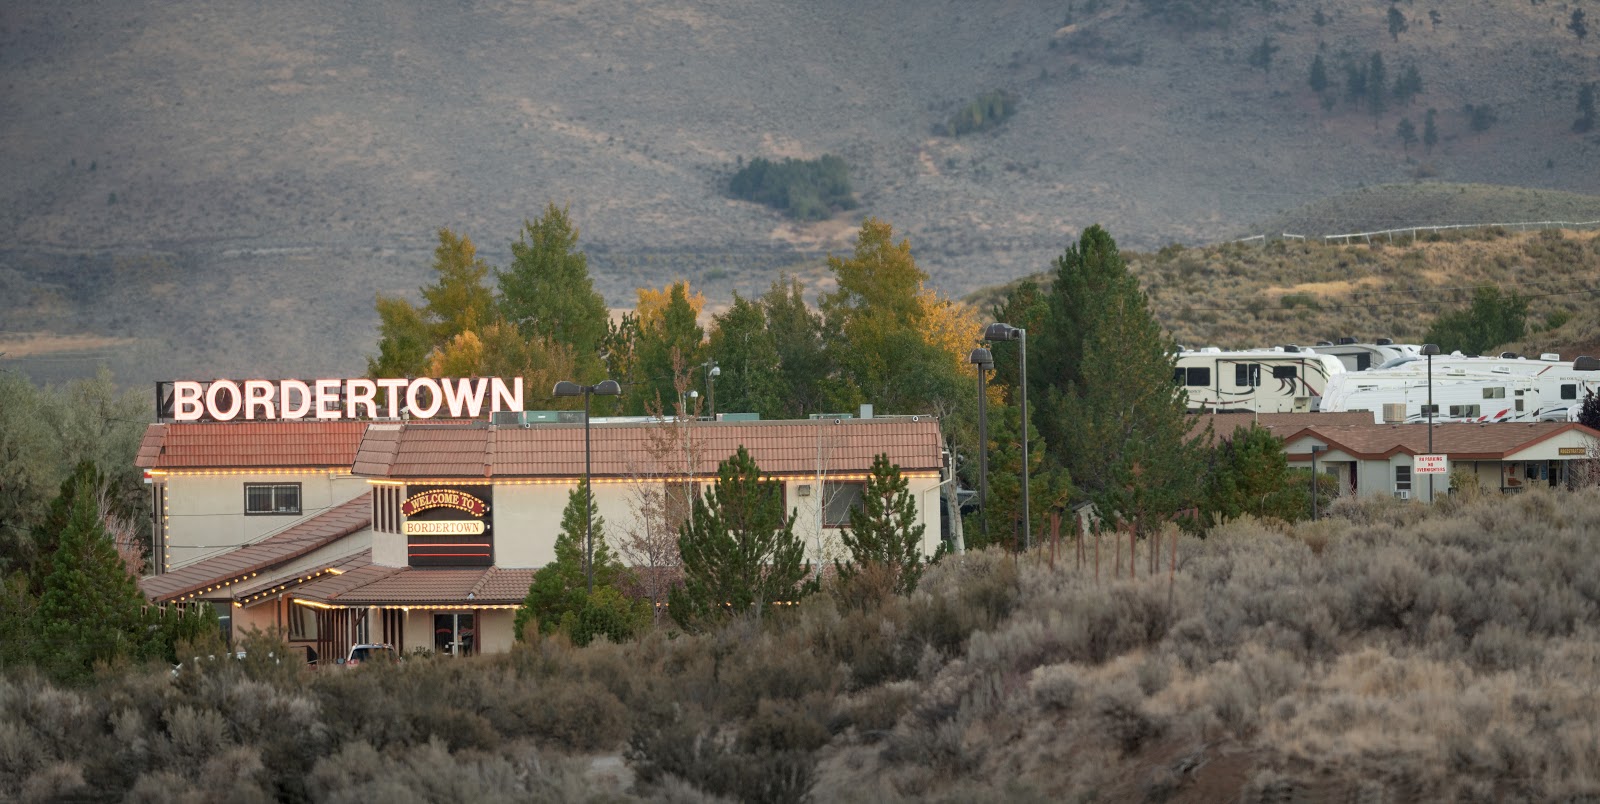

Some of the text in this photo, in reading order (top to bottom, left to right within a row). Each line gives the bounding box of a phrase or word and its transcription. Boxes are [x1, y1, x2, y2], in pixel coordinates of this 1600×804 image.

[174, 377, 524, 420] BORDERTOWN
[410, 493, 475, 509] WELCOME TO
[407, 522, 480, 533] BORDERTOWN
